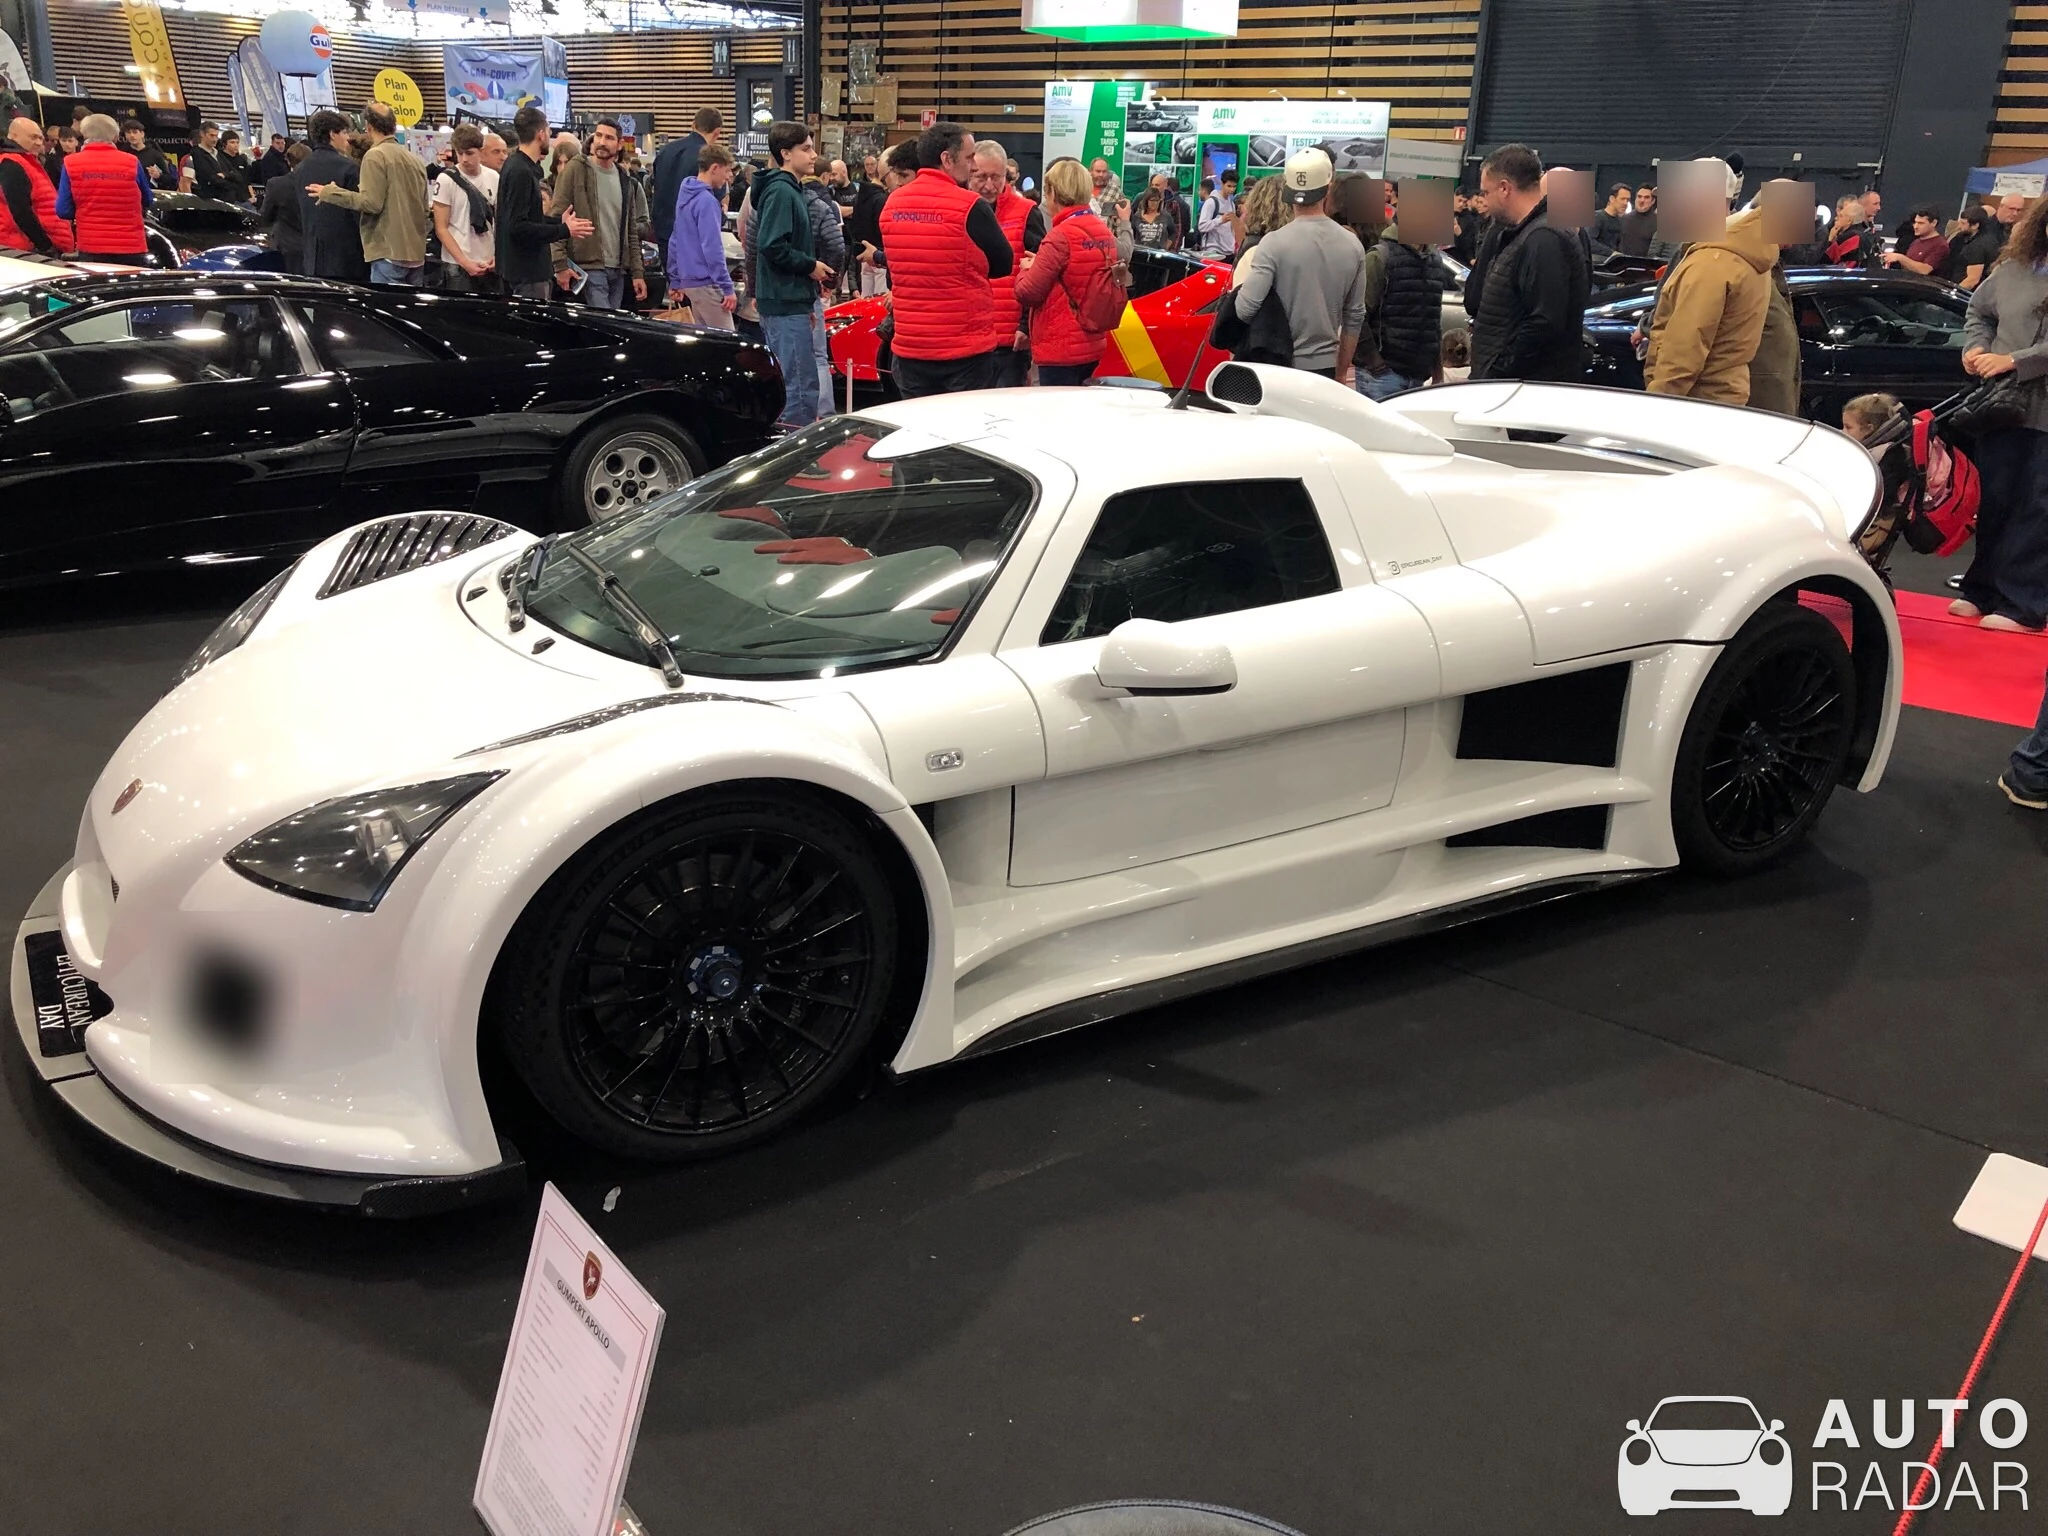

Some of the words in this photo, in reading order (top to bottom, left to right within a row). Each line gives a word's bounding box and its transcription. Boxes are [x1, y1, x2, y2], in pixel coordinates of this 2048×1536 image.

[309, 34, 331, 48] Gul
[384, 78, 408, 90] Plan
[393, 92, 405, 101] du
[394, 105, 416, 116] alon
[1101, 138, 1118, 146] TARIFS
[1292, 138, 1317, 147] TESTEZ
[38, 1003, 66, 1029] DAY
[557, 1279, 586, 1319] GUMPERT
[585, 1315, 610, 1349] APOLLO
